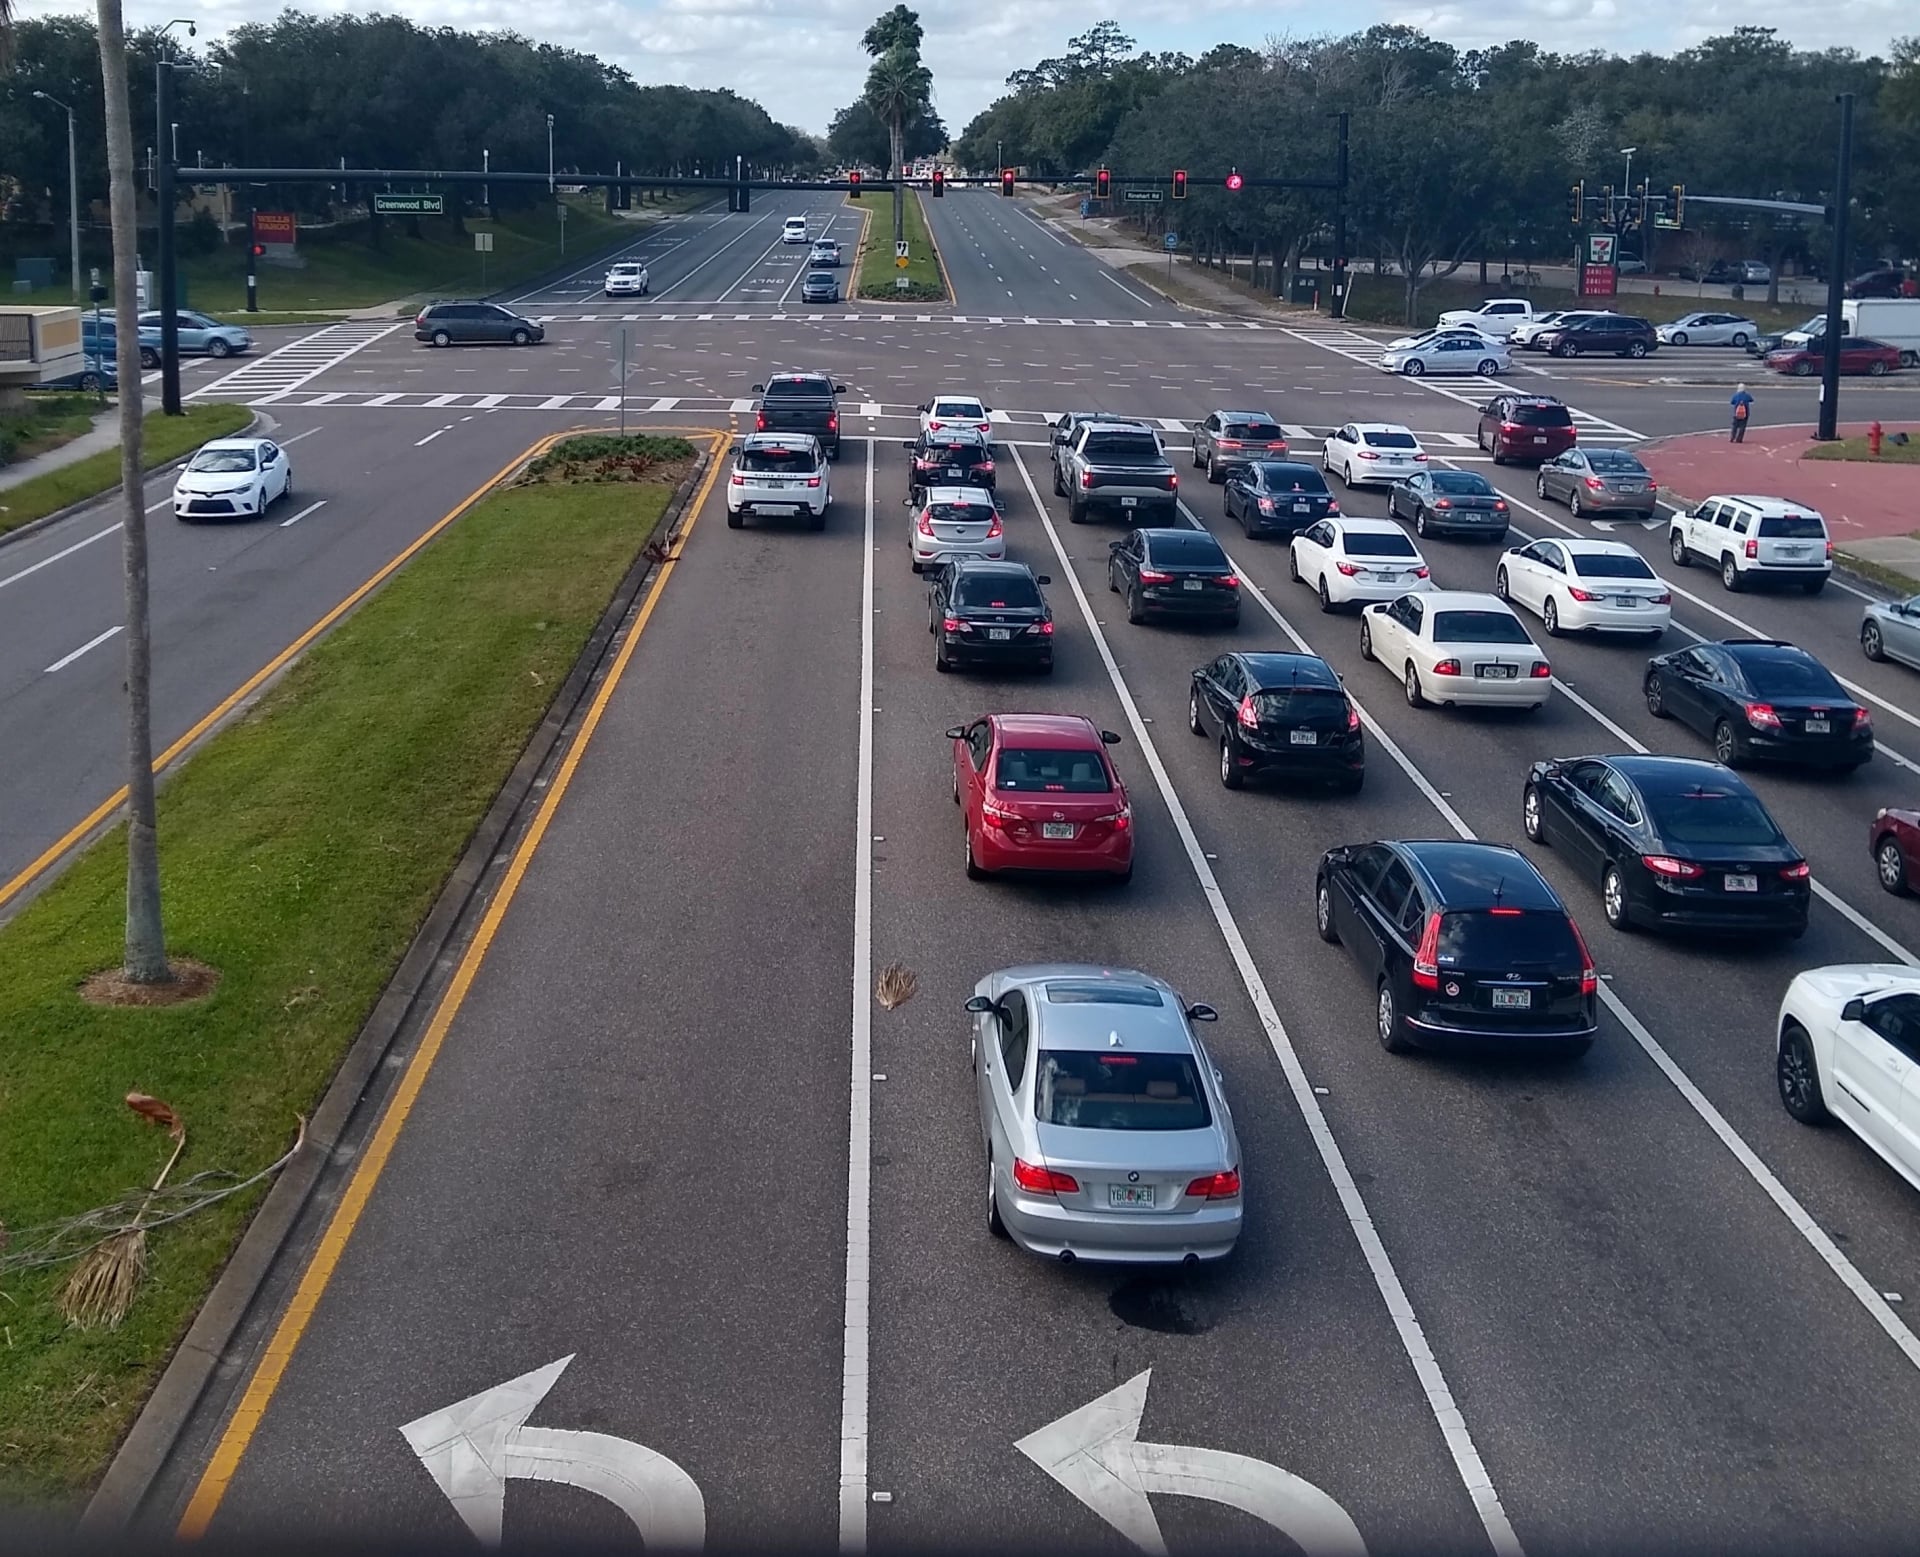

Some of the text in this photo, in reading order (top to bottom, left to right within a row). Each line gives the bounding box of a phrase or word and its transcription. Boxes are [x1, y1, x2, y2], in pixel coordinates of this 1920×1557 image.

[377, 200, 440, 210] Greenwood Blvd
[1593, 240, 1610, 250] 7
